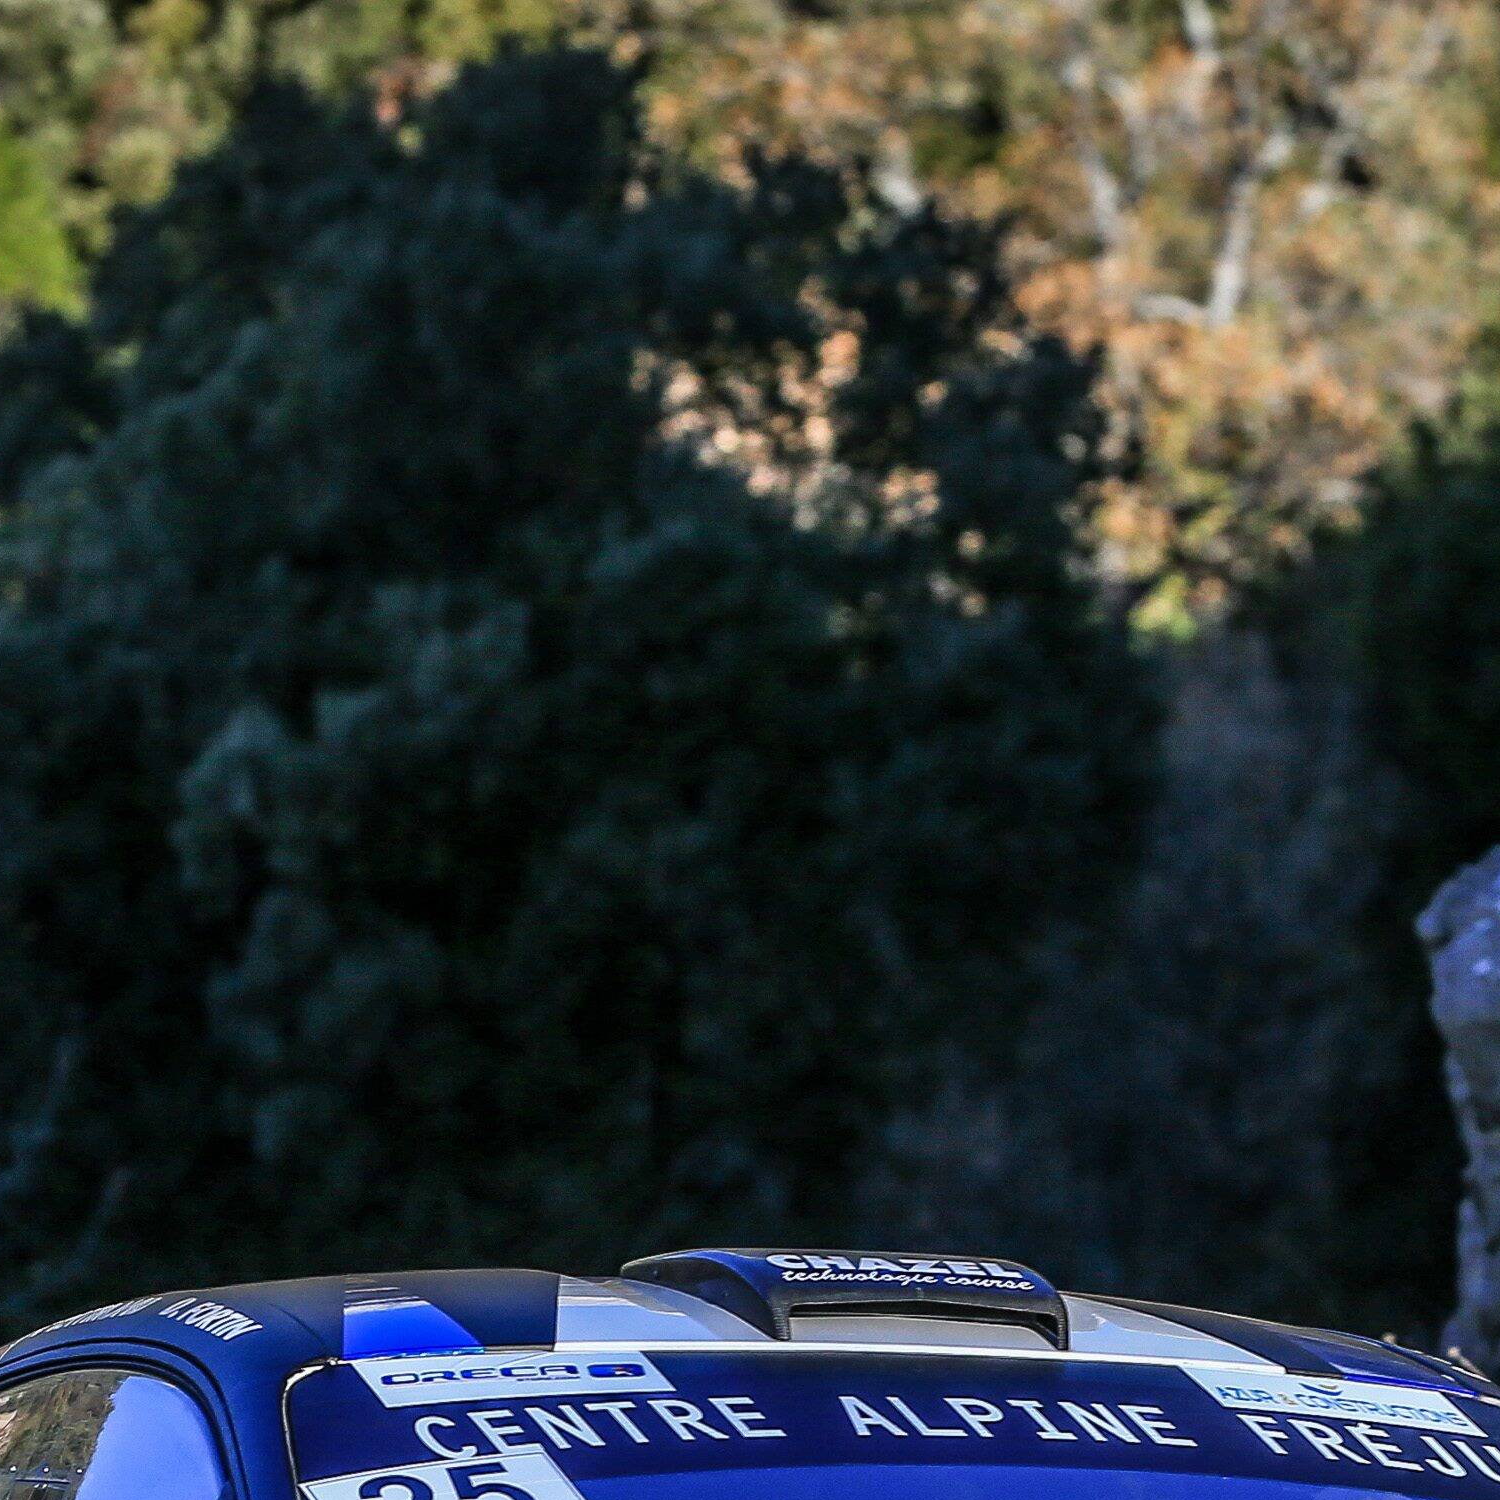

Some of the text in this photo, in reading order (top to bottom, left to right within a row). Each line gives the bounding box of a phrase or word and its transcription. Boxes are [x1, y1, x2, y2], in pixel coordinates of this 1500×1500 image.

[766, 1253, 1023, 1279] CHAZEL
[781, 1269, 1036, 1291] technologie course
[381, 1364, 579, 1386] ORECA
[414, 1396, 787, 1460] CENTRE
[838, 1395, 1199, 1448] ALPINE
